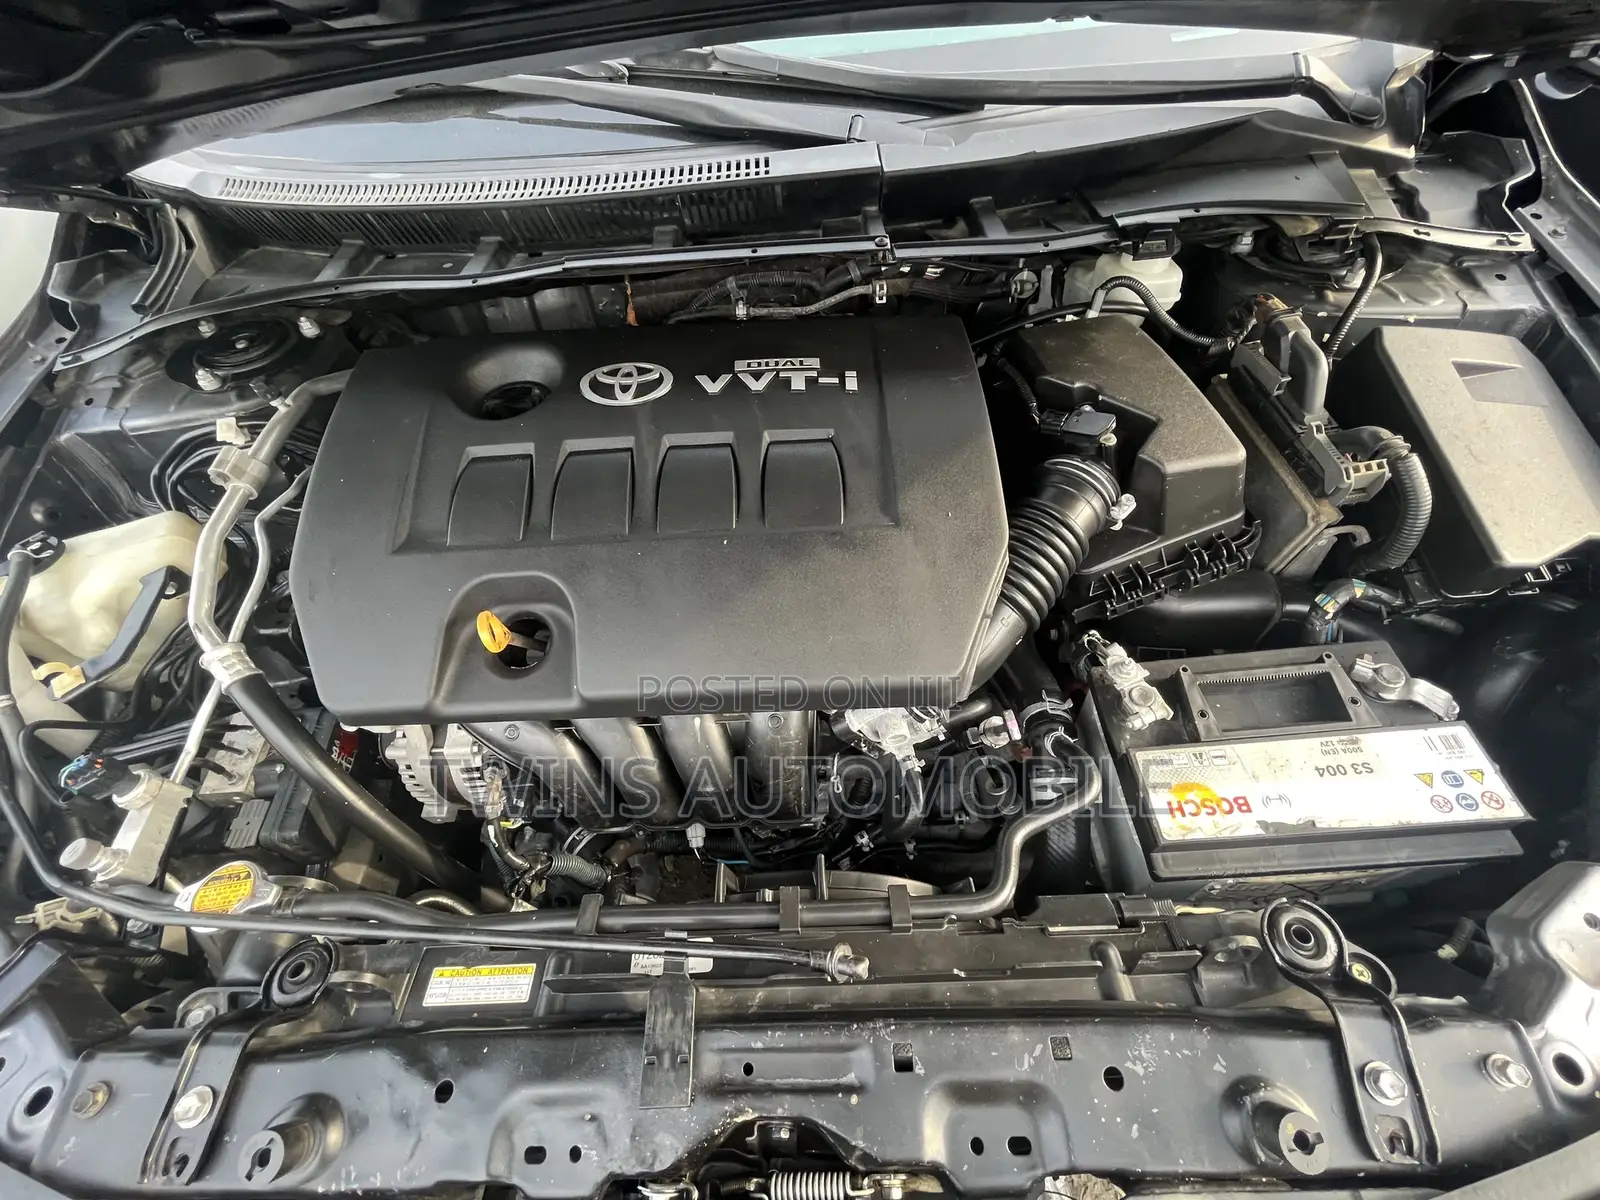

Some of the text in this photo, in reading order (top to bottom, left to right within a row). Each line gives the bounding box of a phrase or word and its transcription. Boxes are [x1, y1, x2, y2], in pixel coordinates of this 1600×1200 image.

[745, 358, 813, 369] DUAL
[1340, 746, 1364, 755] 500A
[1314, 762, 1374, 778] S3 004
[1166, 795, 1253, 819] BOSCH
[450, 967, 529, 977] CAUTION ATTENTION
